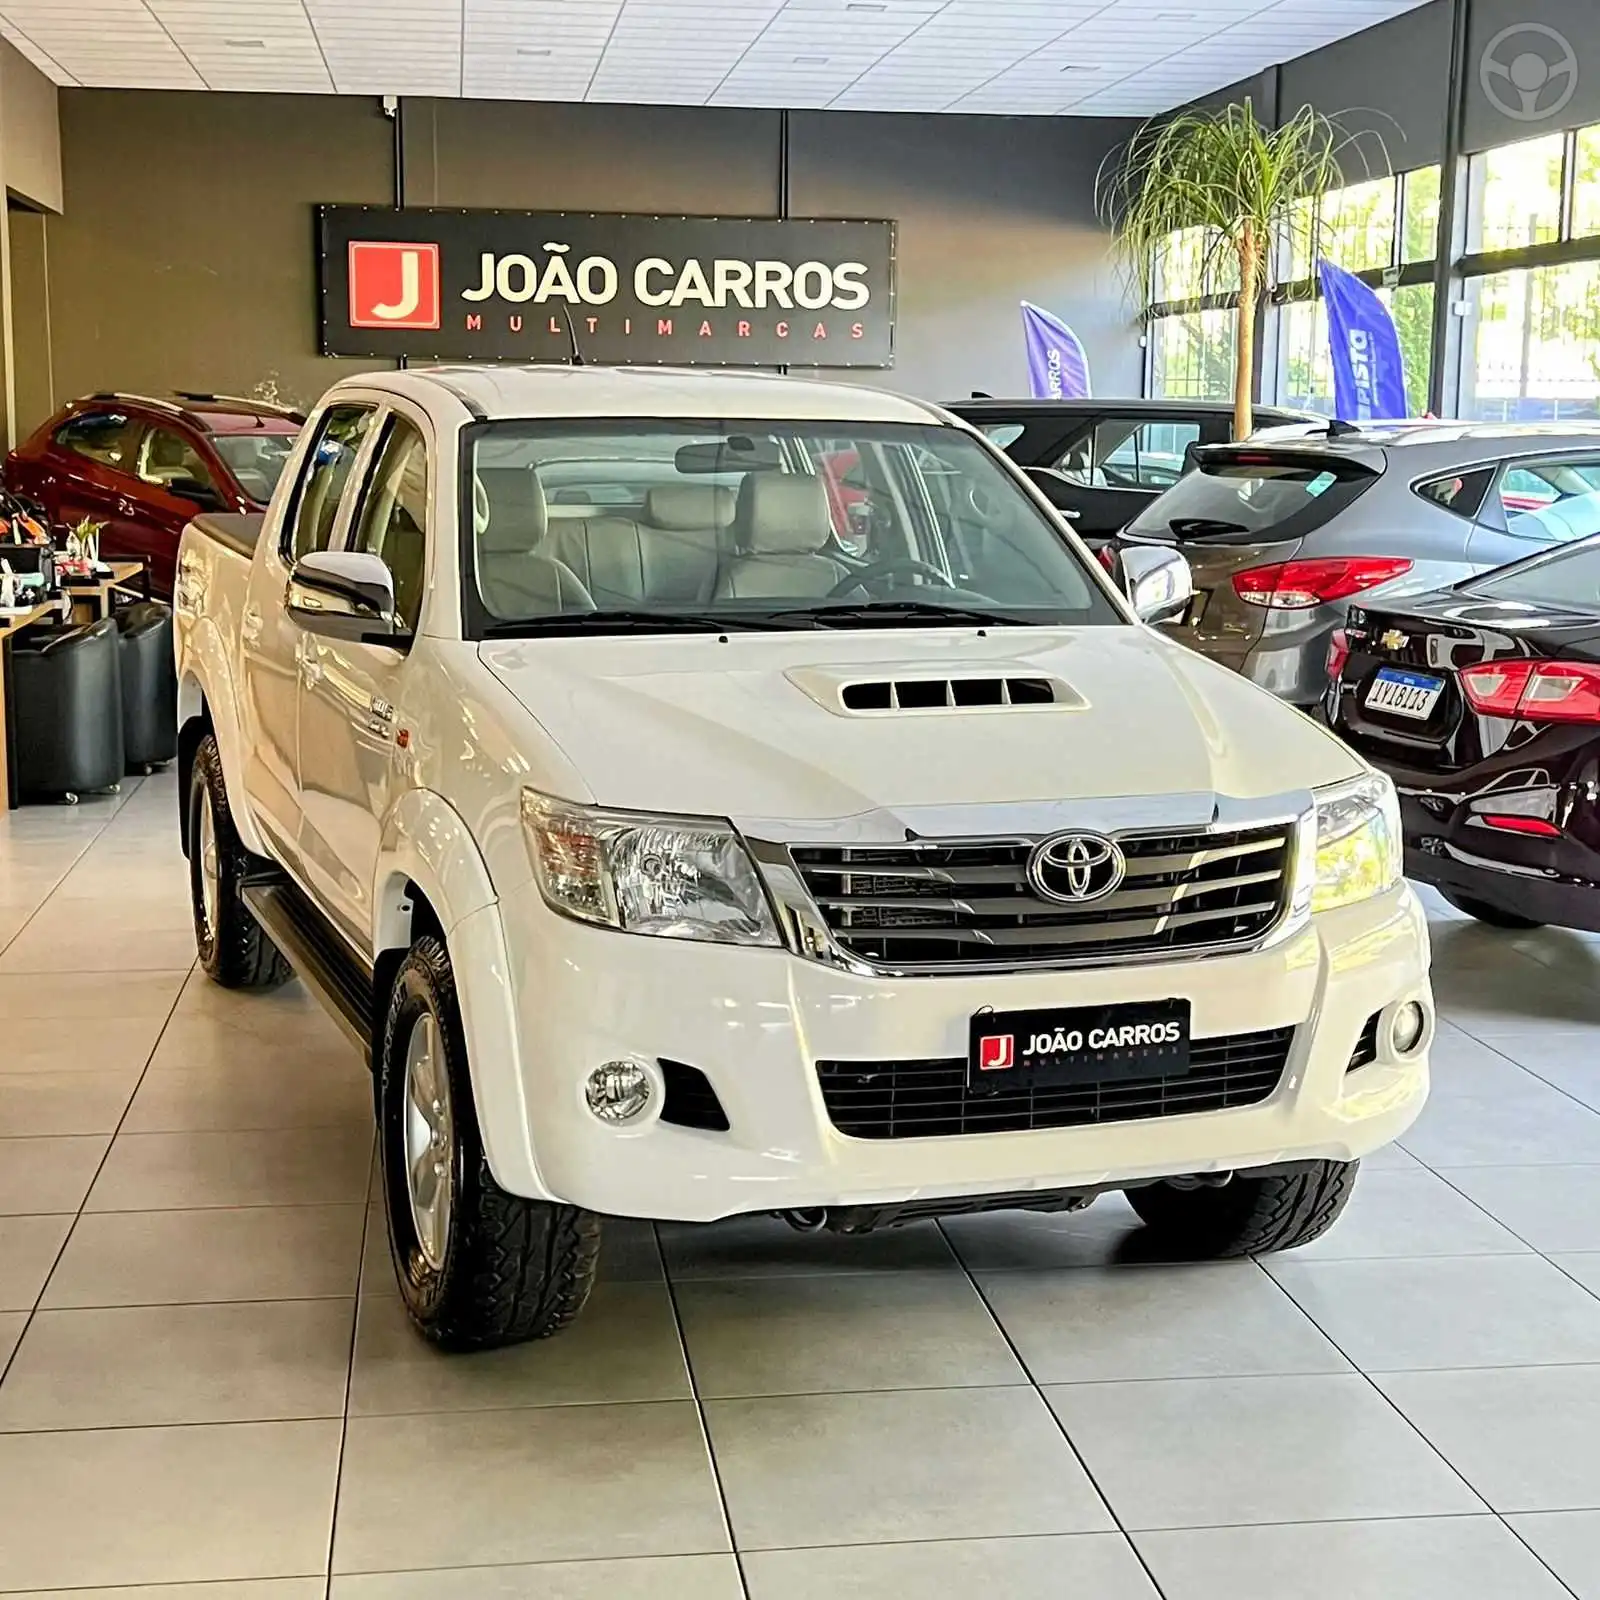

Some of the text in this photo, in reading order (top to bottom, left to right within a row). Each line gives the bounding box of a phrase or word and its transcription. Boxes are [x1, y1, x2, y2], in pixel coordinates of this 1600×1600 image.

[461, 241, 870, 311] JOÃO CARROS
[466, 314, 864, 339] MULTIMARCAS
[1022, 1021, 1180, 1056] JOÃO CARROS
